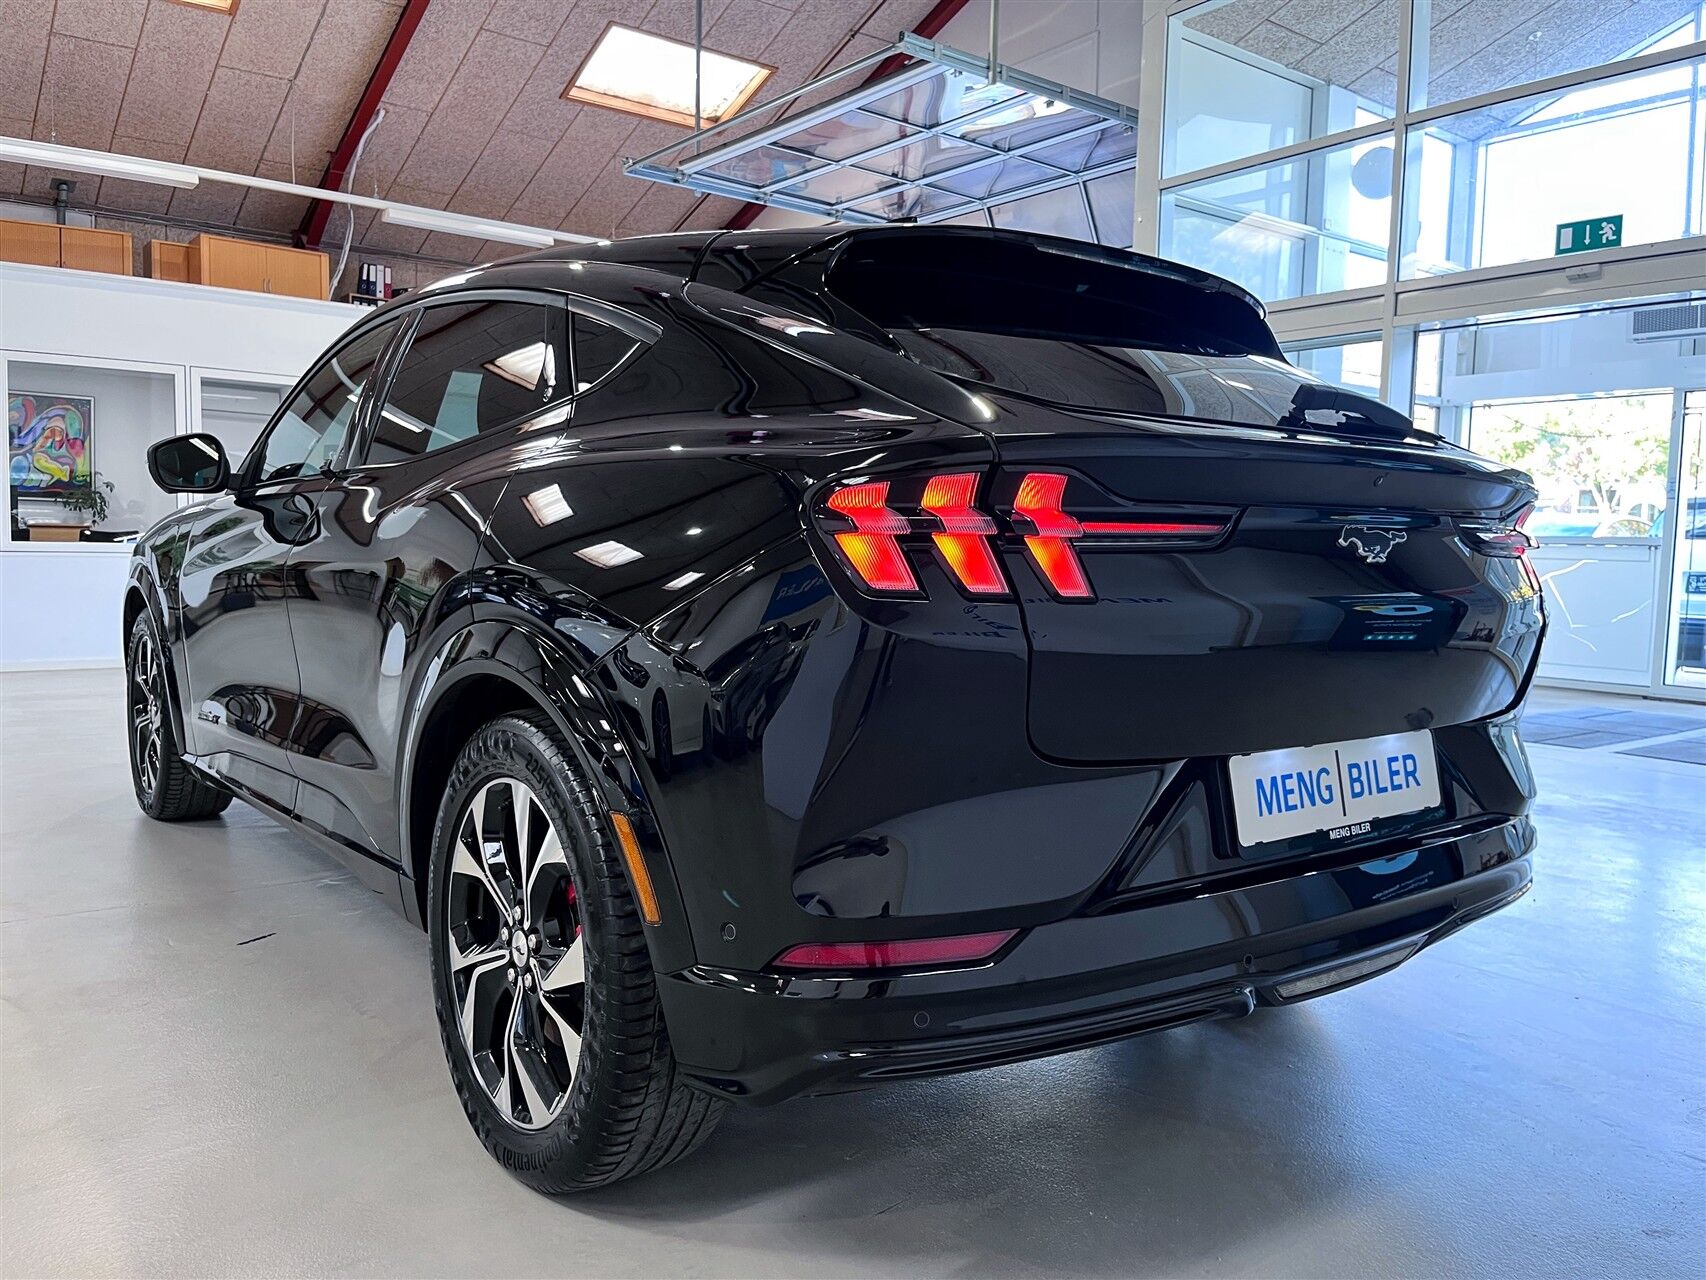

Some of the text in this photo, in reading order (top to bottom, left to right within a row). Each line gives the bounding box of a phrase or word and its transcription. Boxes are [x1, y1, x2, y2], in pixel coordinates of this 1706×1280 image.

[1255, 753, 1421, 817] MENG BILER
[1329, 823, 1371, 840] MENG BILER
